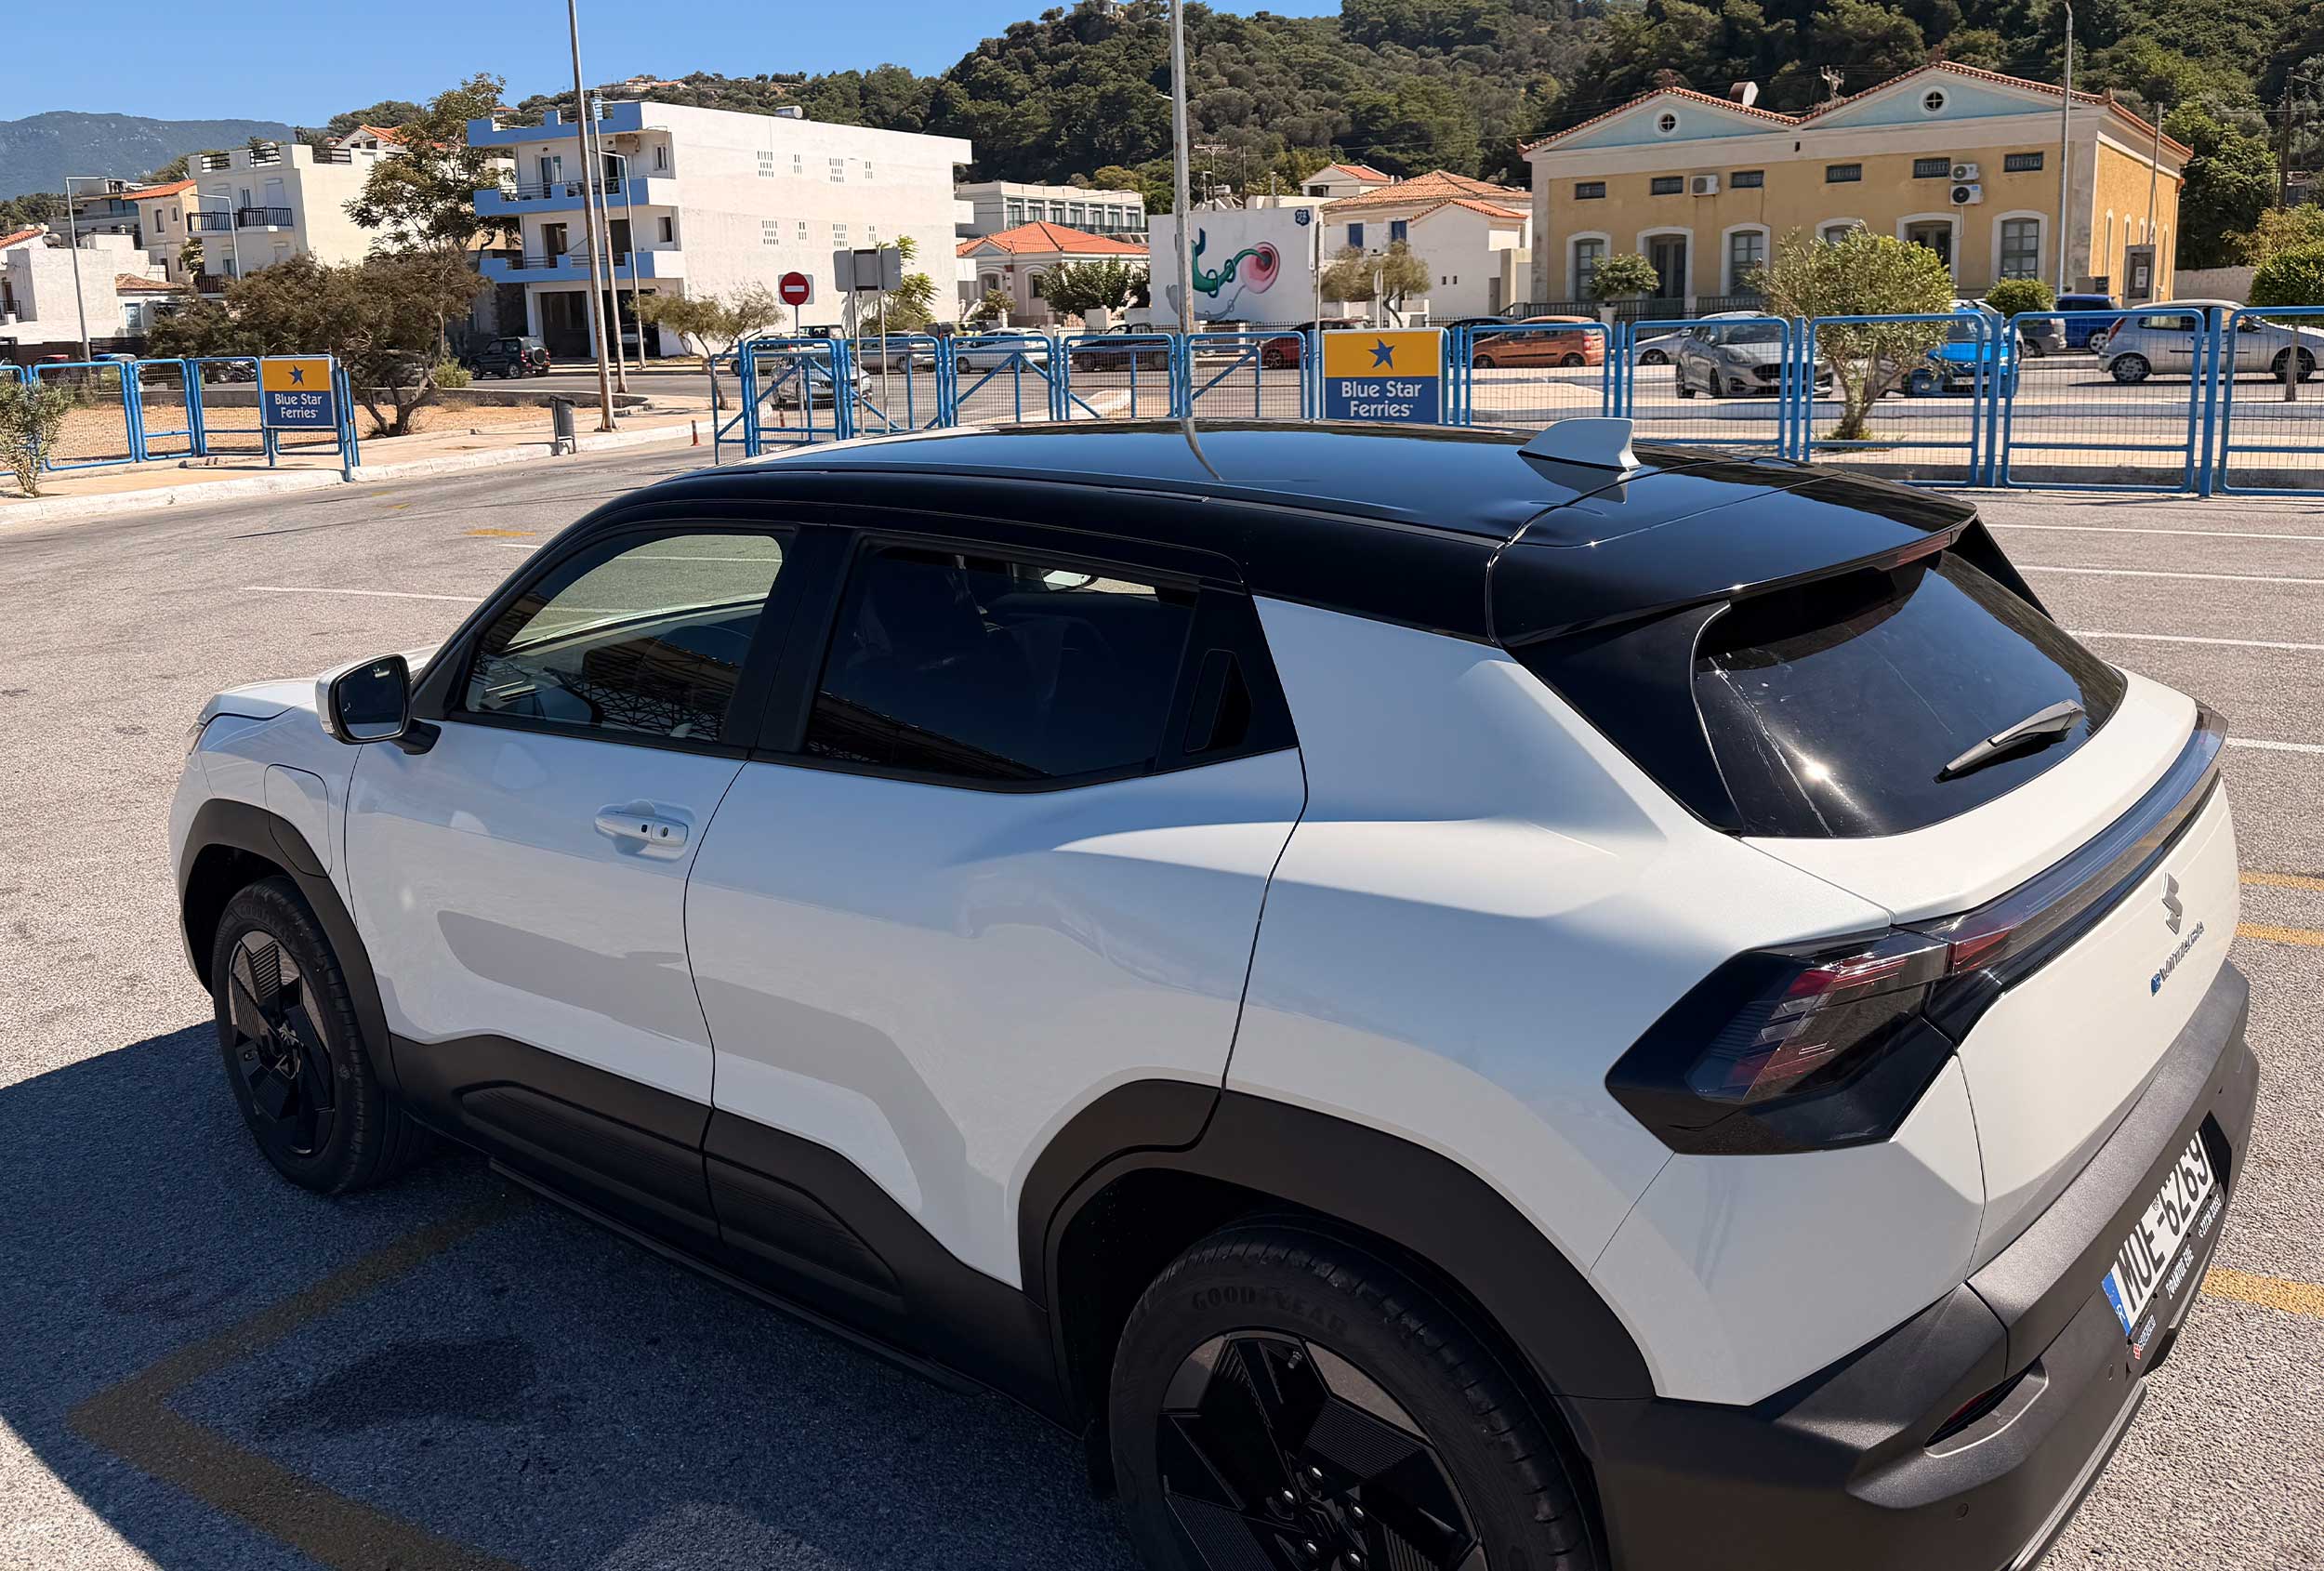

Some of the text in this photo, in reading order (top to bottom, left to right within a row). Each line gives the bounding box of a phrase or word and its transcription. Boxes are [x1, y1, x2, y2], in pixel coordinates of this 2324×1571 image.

[1341, 380, 1422, 398] Blue Star
[274, 393, 323, 405] Blue Star
[281, 406, 317, 418] Ferries
[1350, 400, 1411, 417] Ferries
